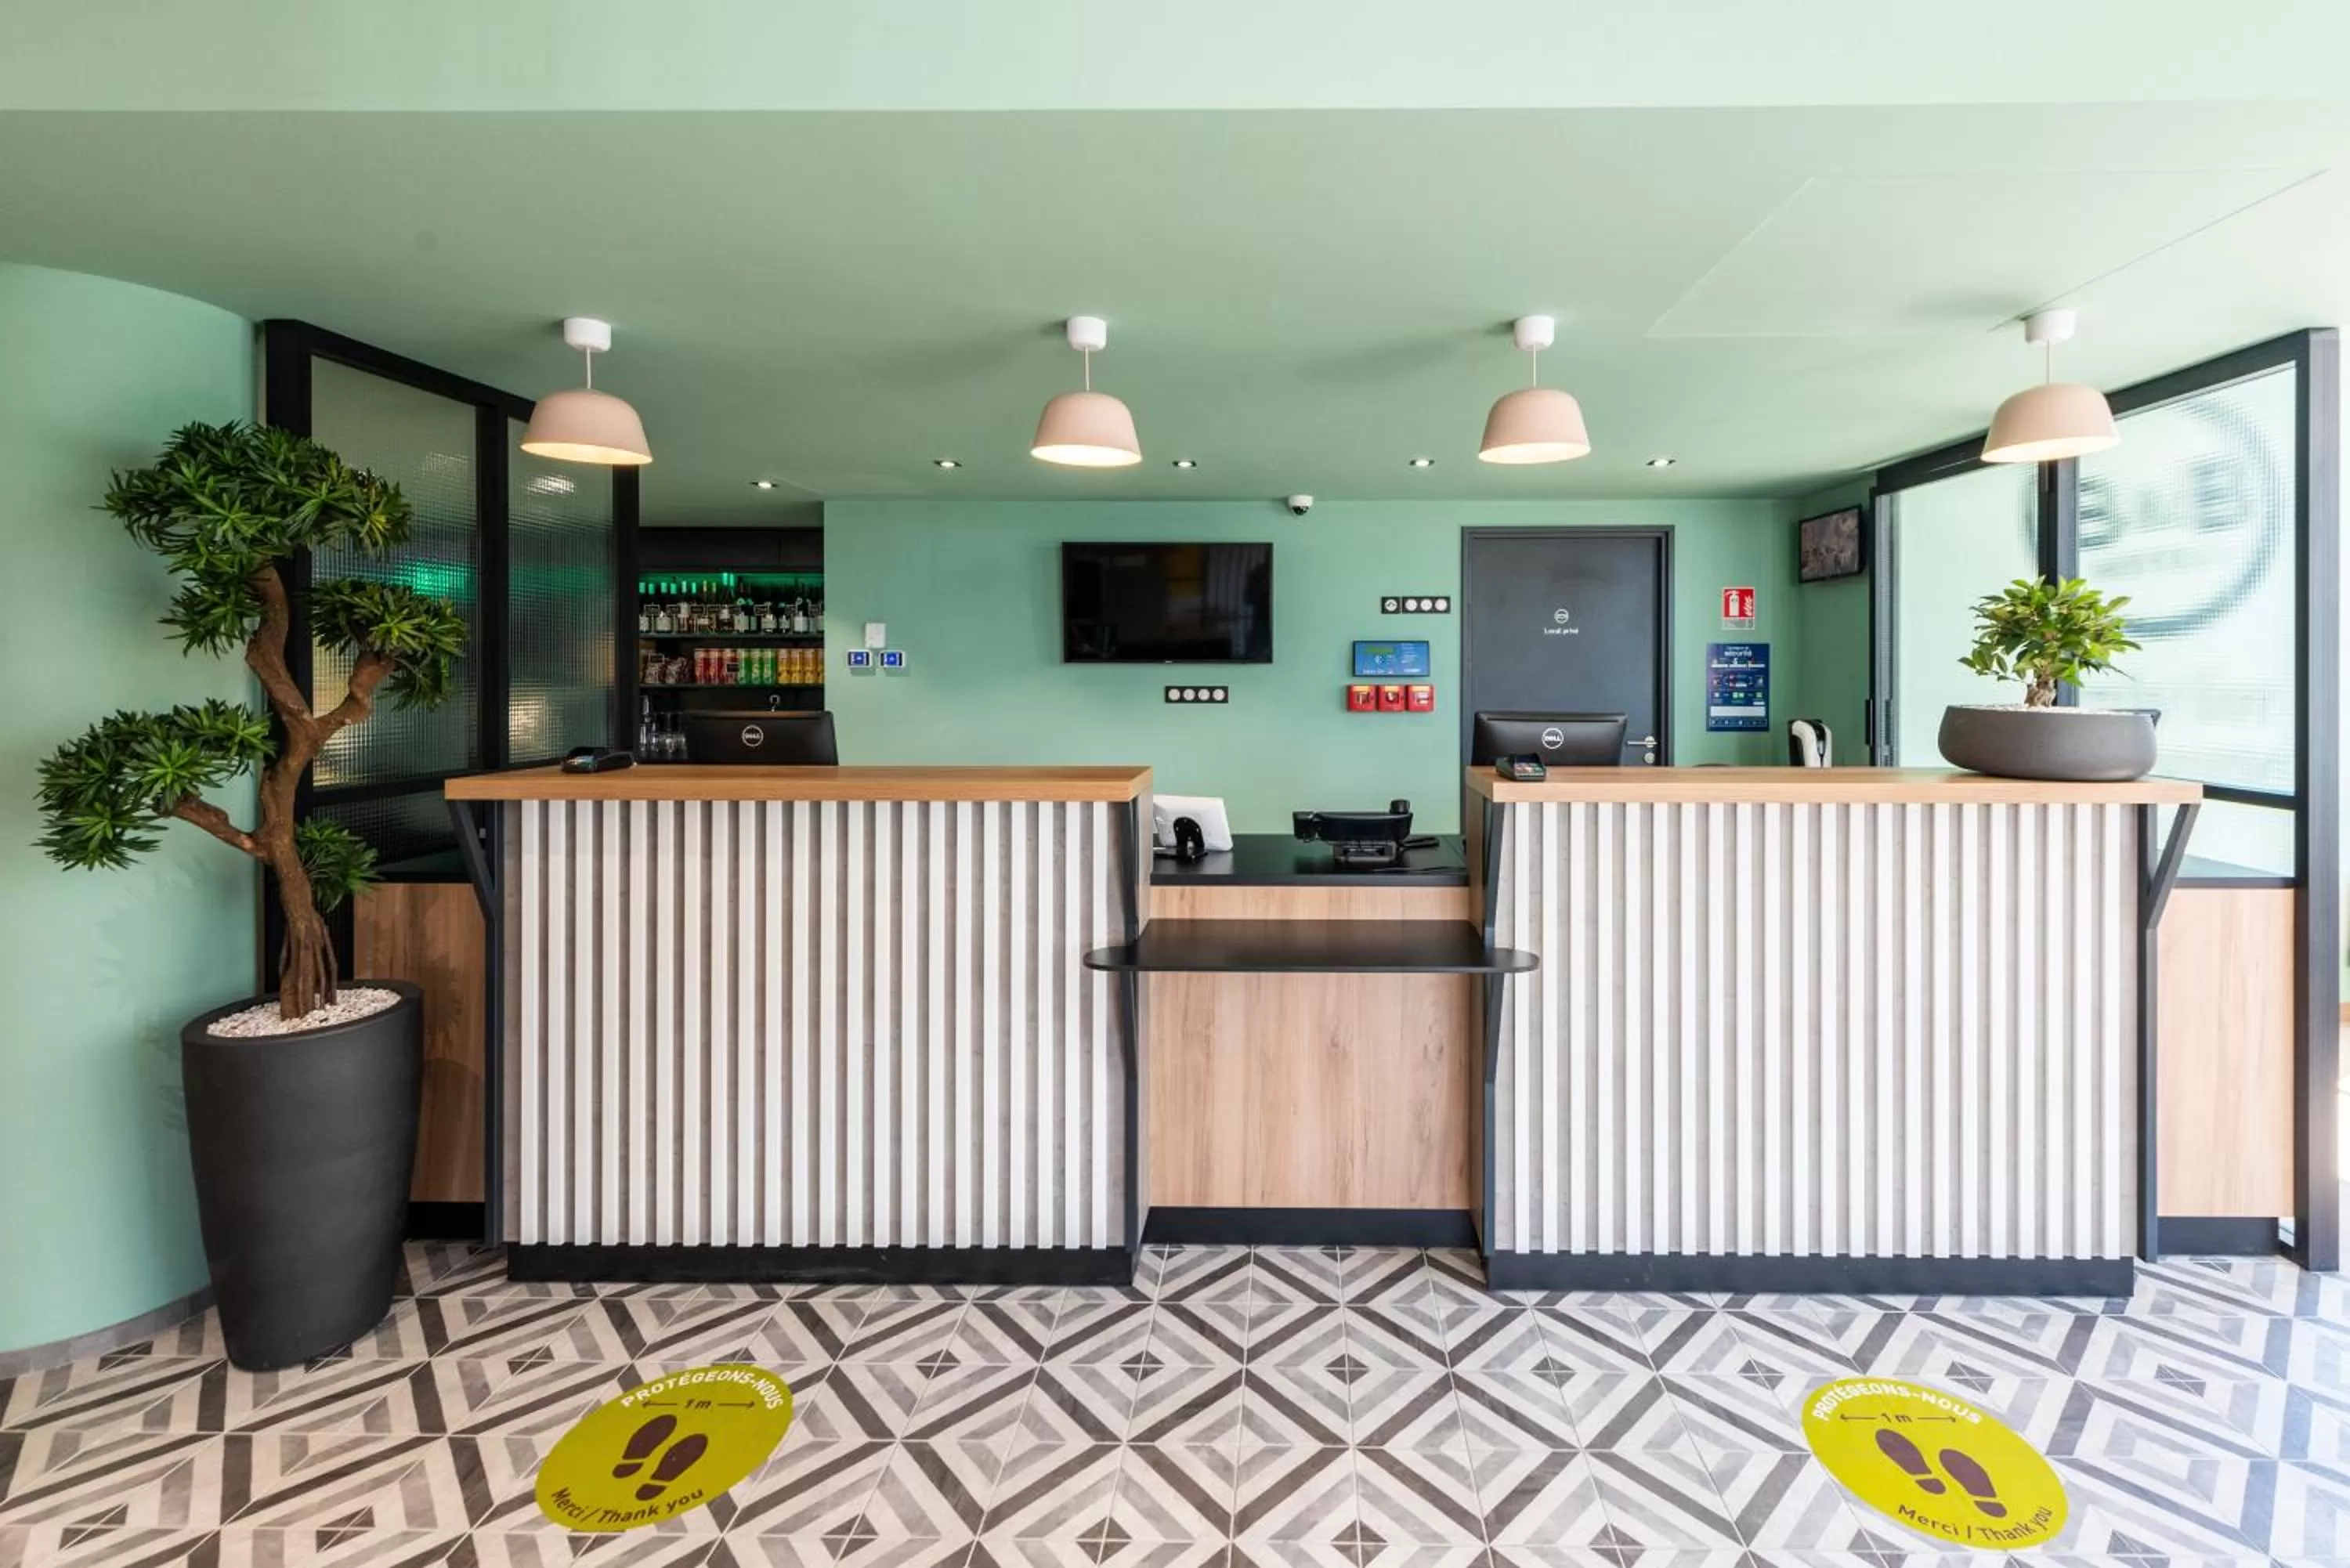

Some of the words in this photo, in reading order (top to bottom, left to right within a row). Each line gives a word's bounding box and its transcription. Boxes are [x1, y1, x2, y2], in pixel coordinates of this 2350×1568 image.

[621, 1370, 783, 1410] PROTÉGEONS-NOUS
[685, 1399, 692, 1407] 1
[695, 1400, 713, 1409] m
[1881, 1413, 1892, 1423] 1
[1895, 1414, 1913, 1423] m
[551, 1487, 589, 1519] Merci
[597, 1505, 660, 1523] Thank
[666, 1489, 703, 1513] you
[1899, 1504, 1959, 1536] Merci
[1976, 1522, 2037, 1541] Thank
[2031, 1506, 2053, 1531] you
